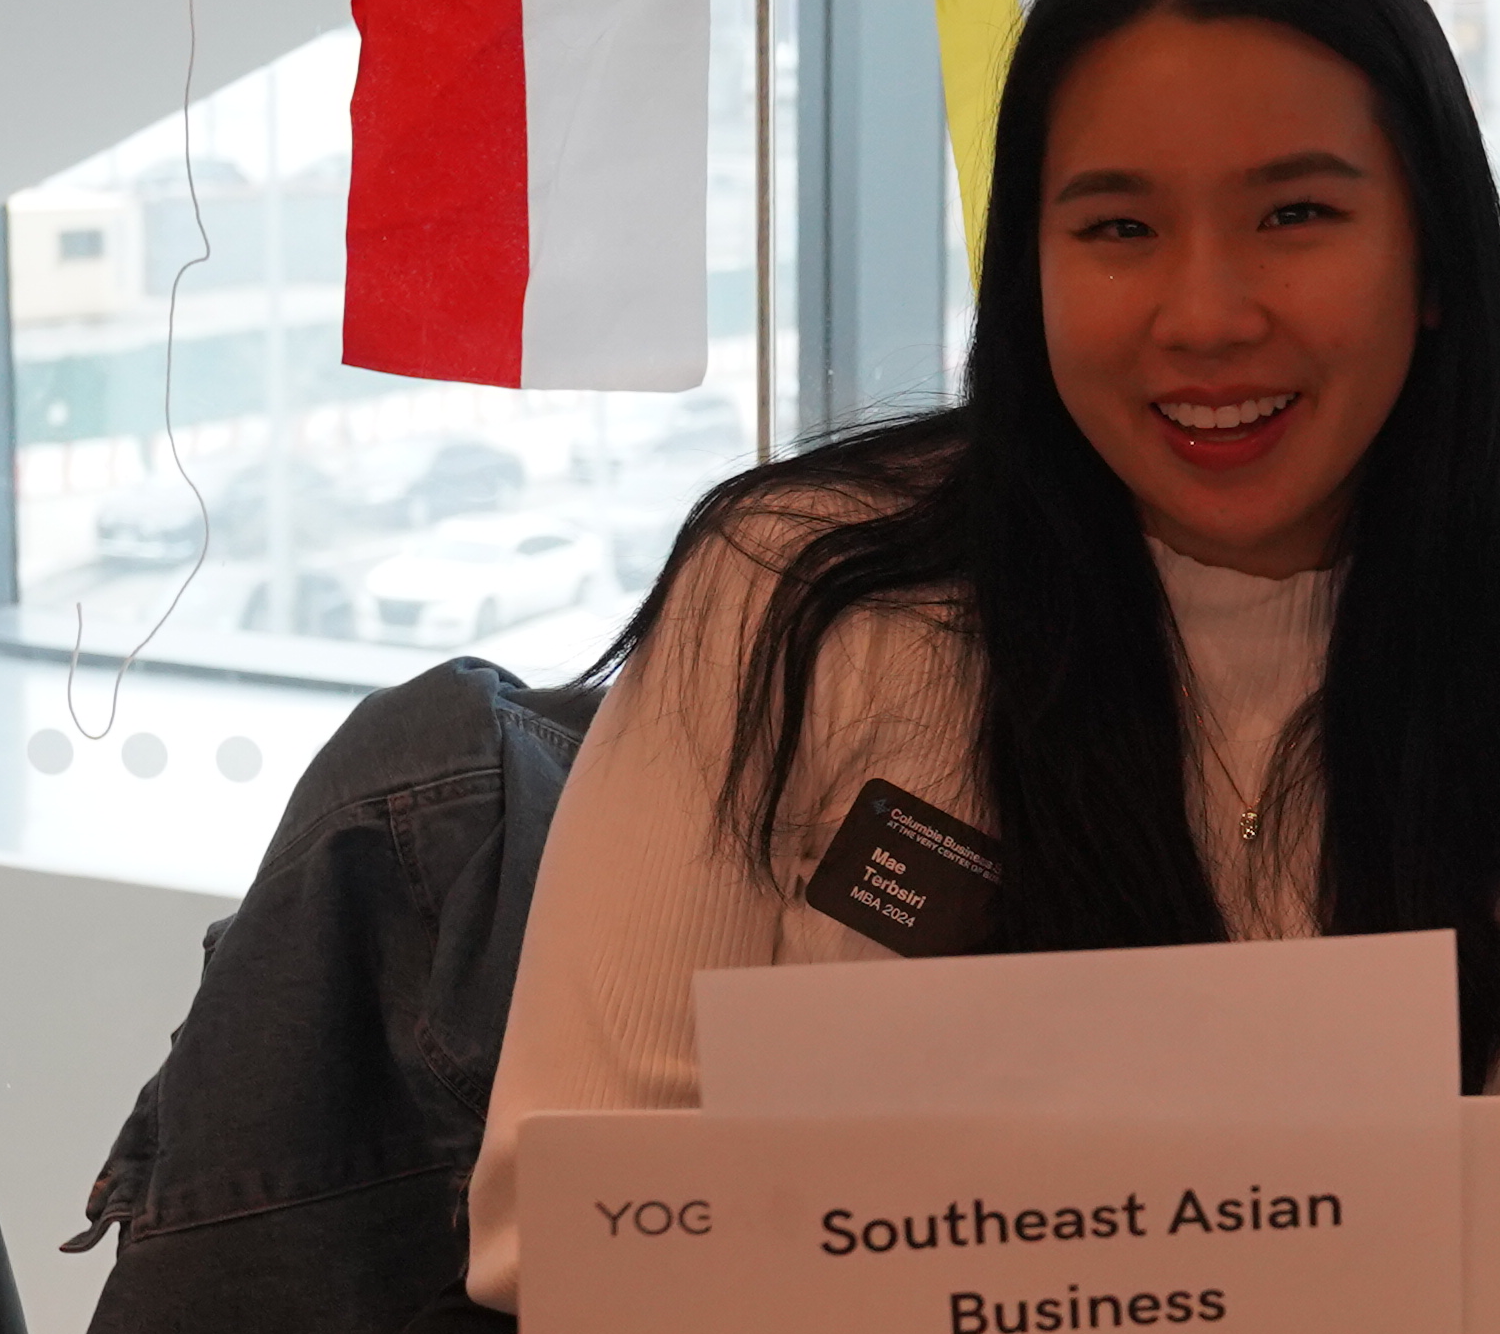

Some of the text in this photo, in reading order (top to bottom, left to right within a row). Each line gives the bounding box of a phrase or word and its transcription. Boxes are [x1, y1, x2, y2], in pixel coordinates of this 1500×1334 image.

[886, 821, 899, 832] AT
[899, 826, 916, 840] THE
[916, 834, 938, 851] VERY
[937, 845, 971, 869] CENTER
[891, 808, 944, 845] Columbia
[871, 847, 907, 875] Mae
[850, 886, 916, 928] MBA 2024
[863, 866, 927, 909] Terbsiri
[595, 1200, 712, 1236] YOG
[821, 1185, 1343, 1257] Southeast Asian
